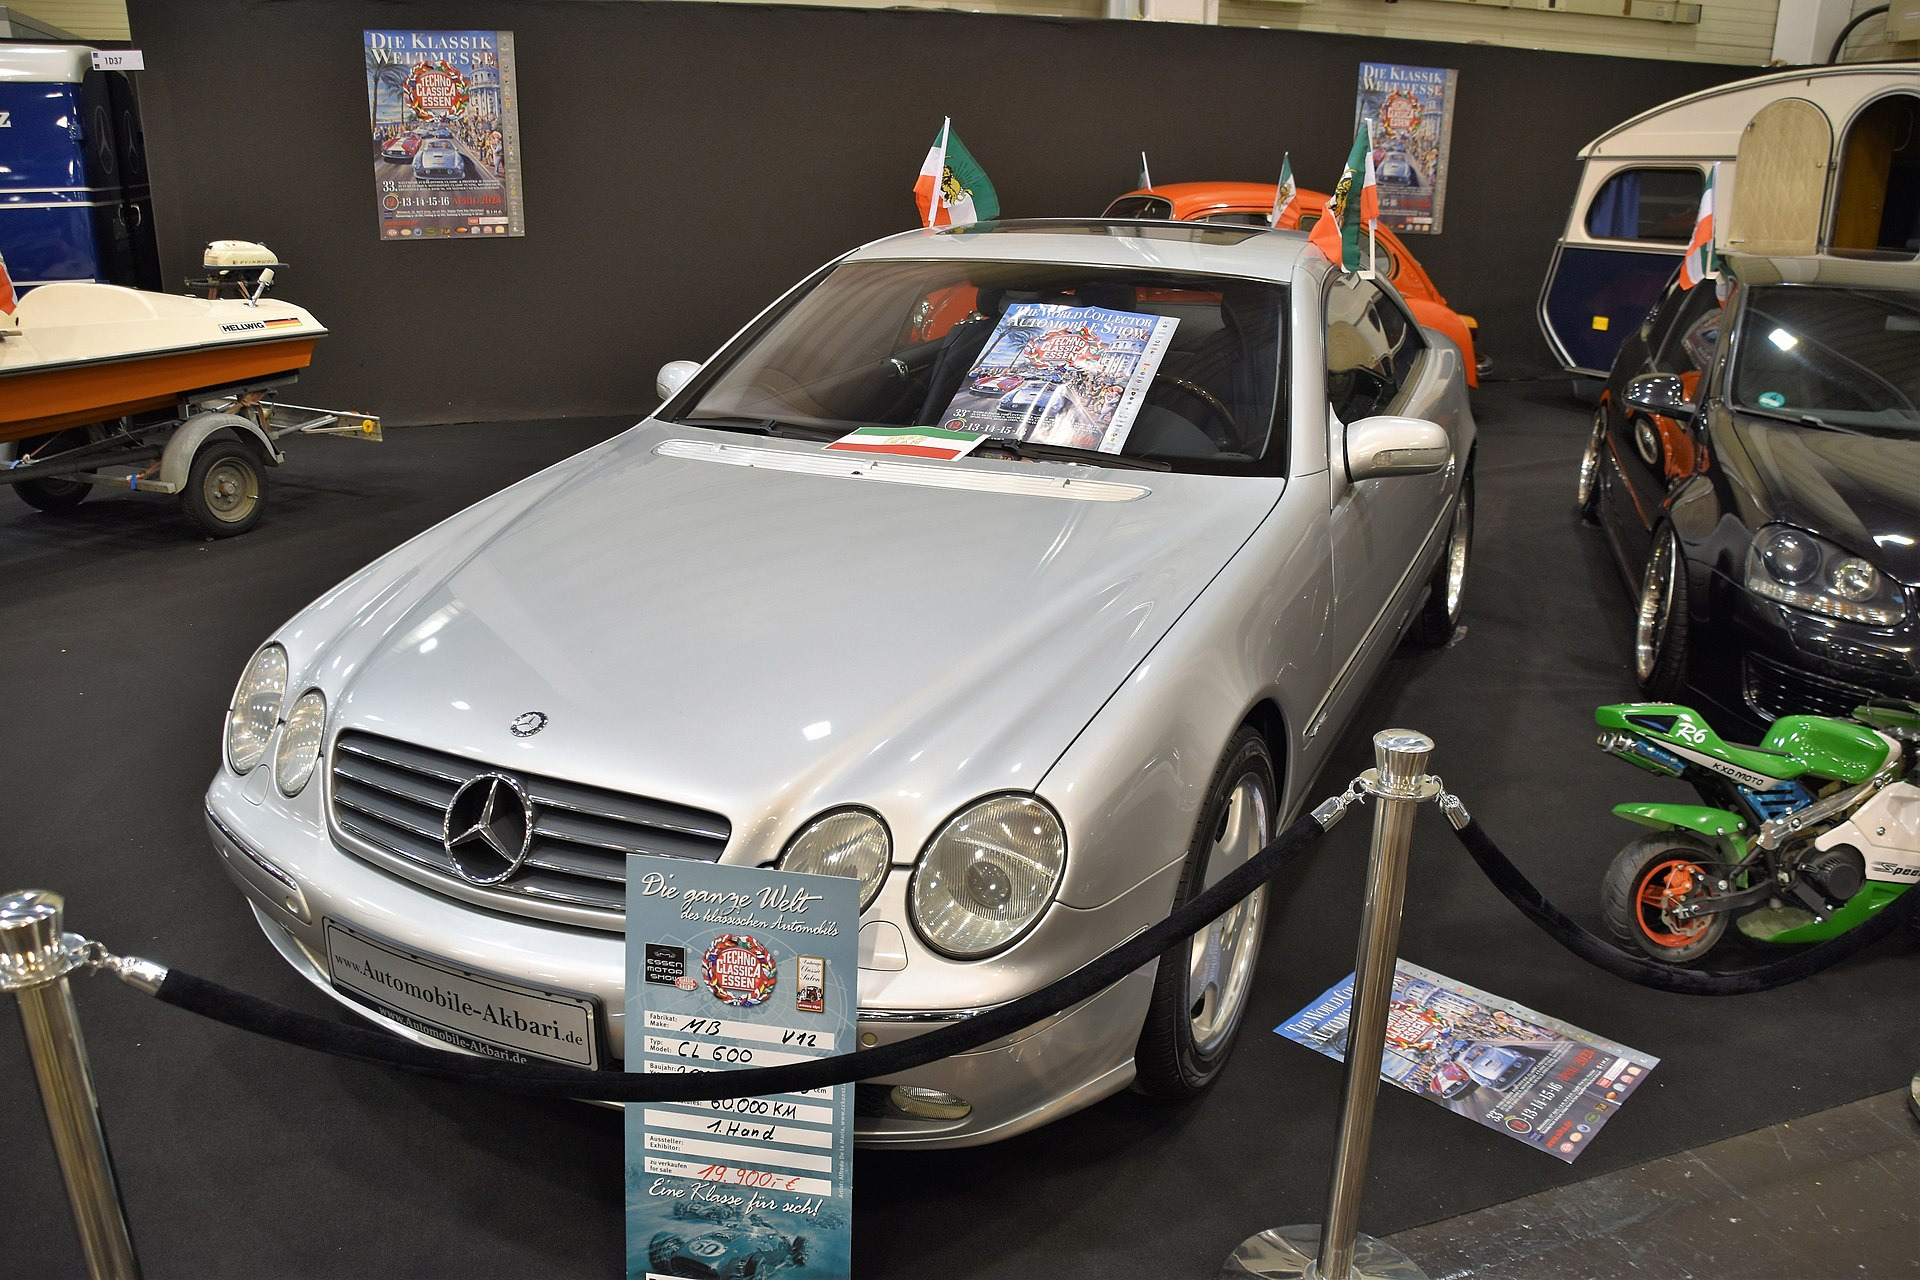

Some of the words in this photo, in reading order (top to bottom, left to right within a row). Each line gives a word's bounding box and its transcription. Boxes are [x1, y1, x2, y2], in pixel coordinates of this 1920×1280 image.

[104, 57, 123, 65] 1D37
[420, 74, 451, 87] TECHNO
[415, 81, 456, 97] CLASSICA
[422, 96, 452, 107] ESSEN
[222, 322, 265, 332] HELLWIG
[1049, 336, 1086, 347] TECHNO
[1041, 341, 1090, 355] CLASSICA
[1043, 351, 1079, 360] ESSEN
[1675, 722, 1708, 743] R6
[1873, 861, 1920, 876] Spee
[641, 871, 680, 900] Die
[682, 888, 753, 916] ganze
[756, 884, 824, 914] Welt
[680, 906, 701, 921] des
[702, 908, 768, 929] klassischen
[770, 916, 839, 937] Automobils
[647, 958, 683, 968] ESSEN
[721, 950, 757, 967] TECHNO
[647, 966, 683, 976] MOTOR
[716, 958, 762, 979] CLASSICA
[721, 974, 756, 990] ESSEN
[335, 953, 584, 1046] www.Automobile-Akbari.de
[649, 1013, 678, 1023] Fabrikat:
[649, 1020, 670, 1029] Make:
[378, 1005, 527, 1065] www.Automobile-Akbari.de
[1400, 1019, 1430, 1044] ESSEN
[649, 1038, 664, 1047] Typ:
[649, 1045, 672, 1054] Model:
[678, 1041, 699, 1059] CL
[712, 1045, 753, 1063] 600
[649, 1062, 677, 1072] Baujahr:
[649, 1135, 684, 1146] Aussteller:
[649, 1142, 681, 1152] Exhibitor:
[649, 1165, 659, 1173] for
[659, 1167, 673, 1175] sale
[658, 1160, 689, 1170] verkaufen
[648, 1177, 686, 1200] Eine
[690, 1182, 744, 1206] Klasse
[745, 1191, 777, 1214] für
[782, 1197, 825, 1217] sich!
